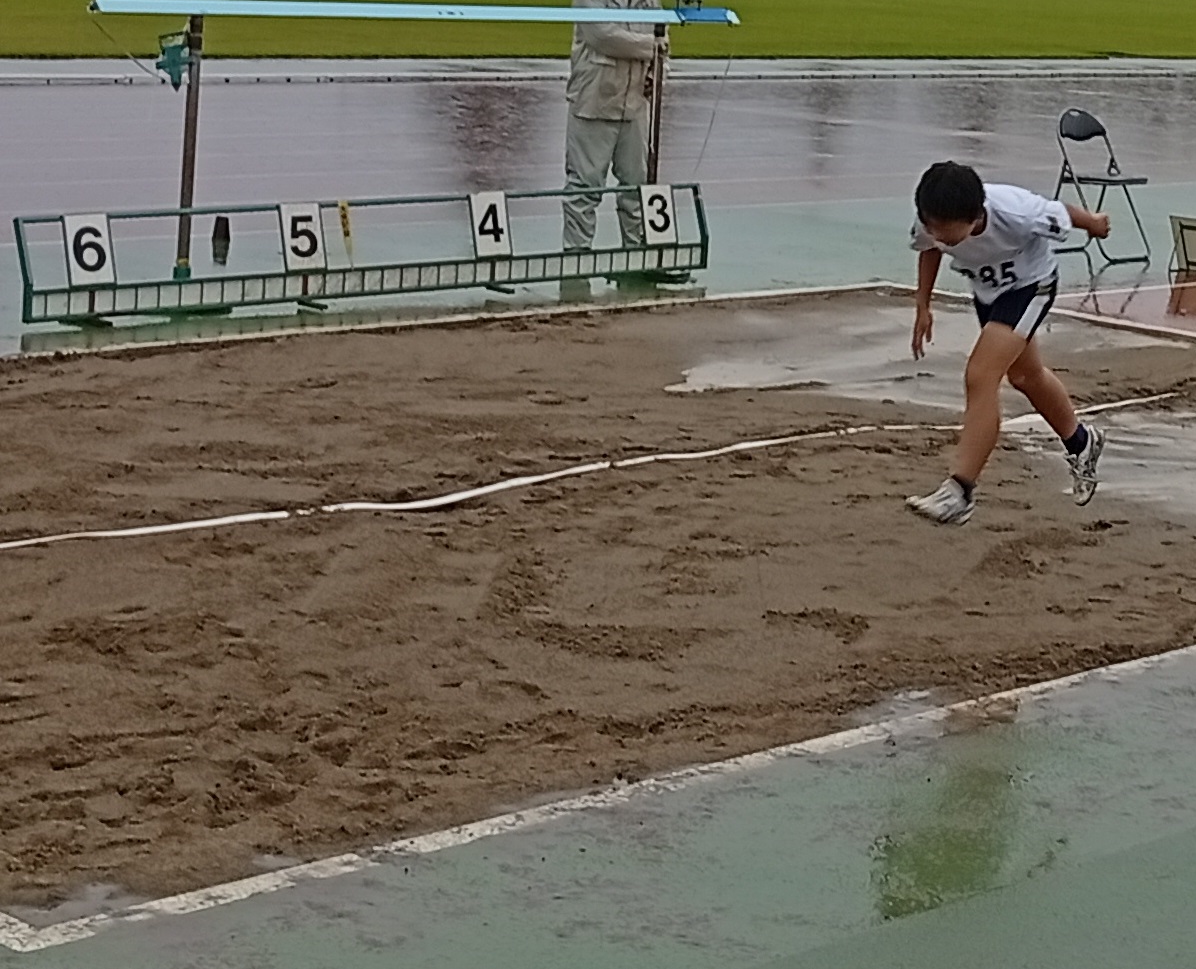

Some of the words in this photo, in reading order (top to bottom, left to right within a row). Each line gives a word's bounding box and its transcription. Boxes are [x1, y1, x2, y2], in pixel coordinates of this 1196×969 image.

[478, 203, 504, 243] 4
[648, 194, 671, 233] 3
[72, 226, 107, 272] 6
[290, 215, 318, 258] 5
